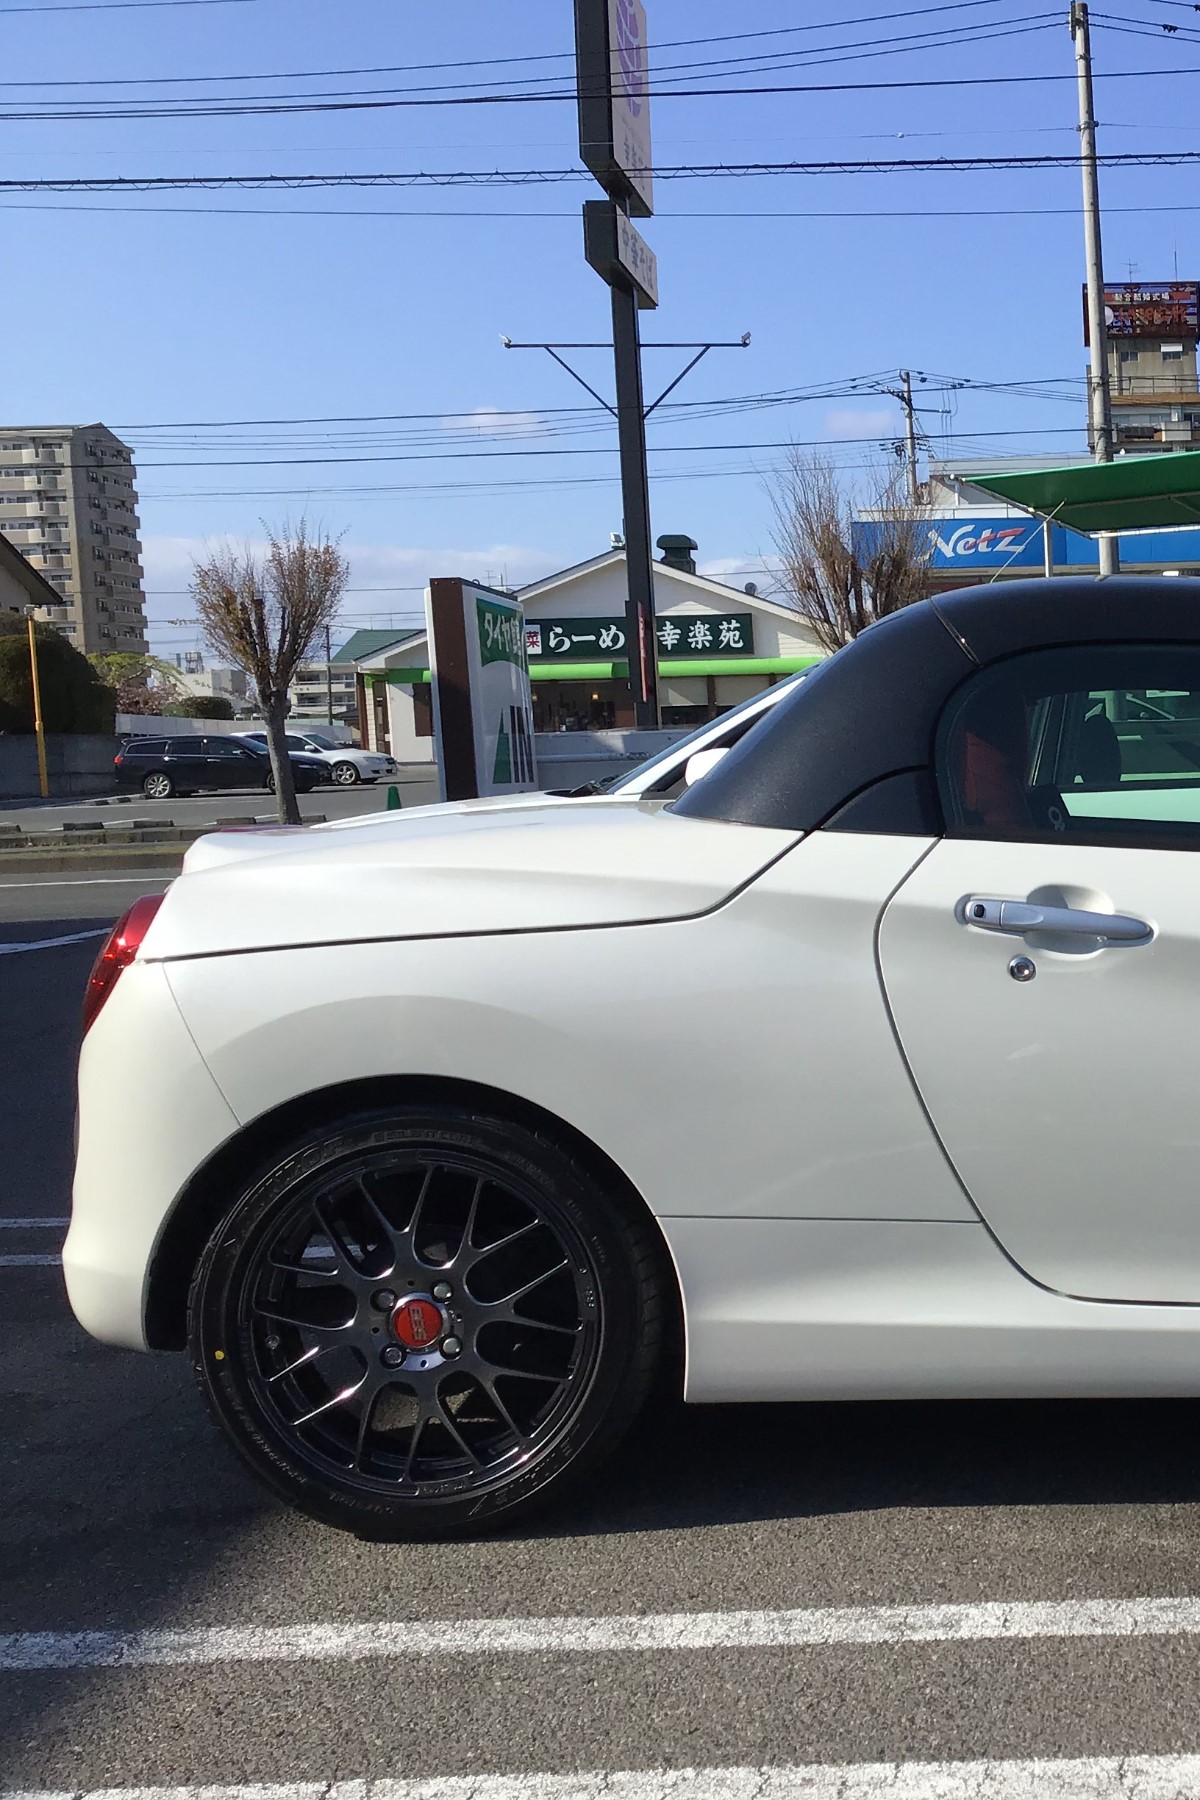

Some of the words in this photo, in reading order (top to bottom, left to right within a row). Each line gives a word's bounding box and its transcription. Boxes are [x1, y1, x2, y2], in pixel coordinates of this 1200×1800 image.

[917, 523, 1026, 562] Netz
[483, 612, 522, 656] タイヤ館
[549, 624, 626, 653] らーめ
[656, 618, 745, 651] 幸楽苑
